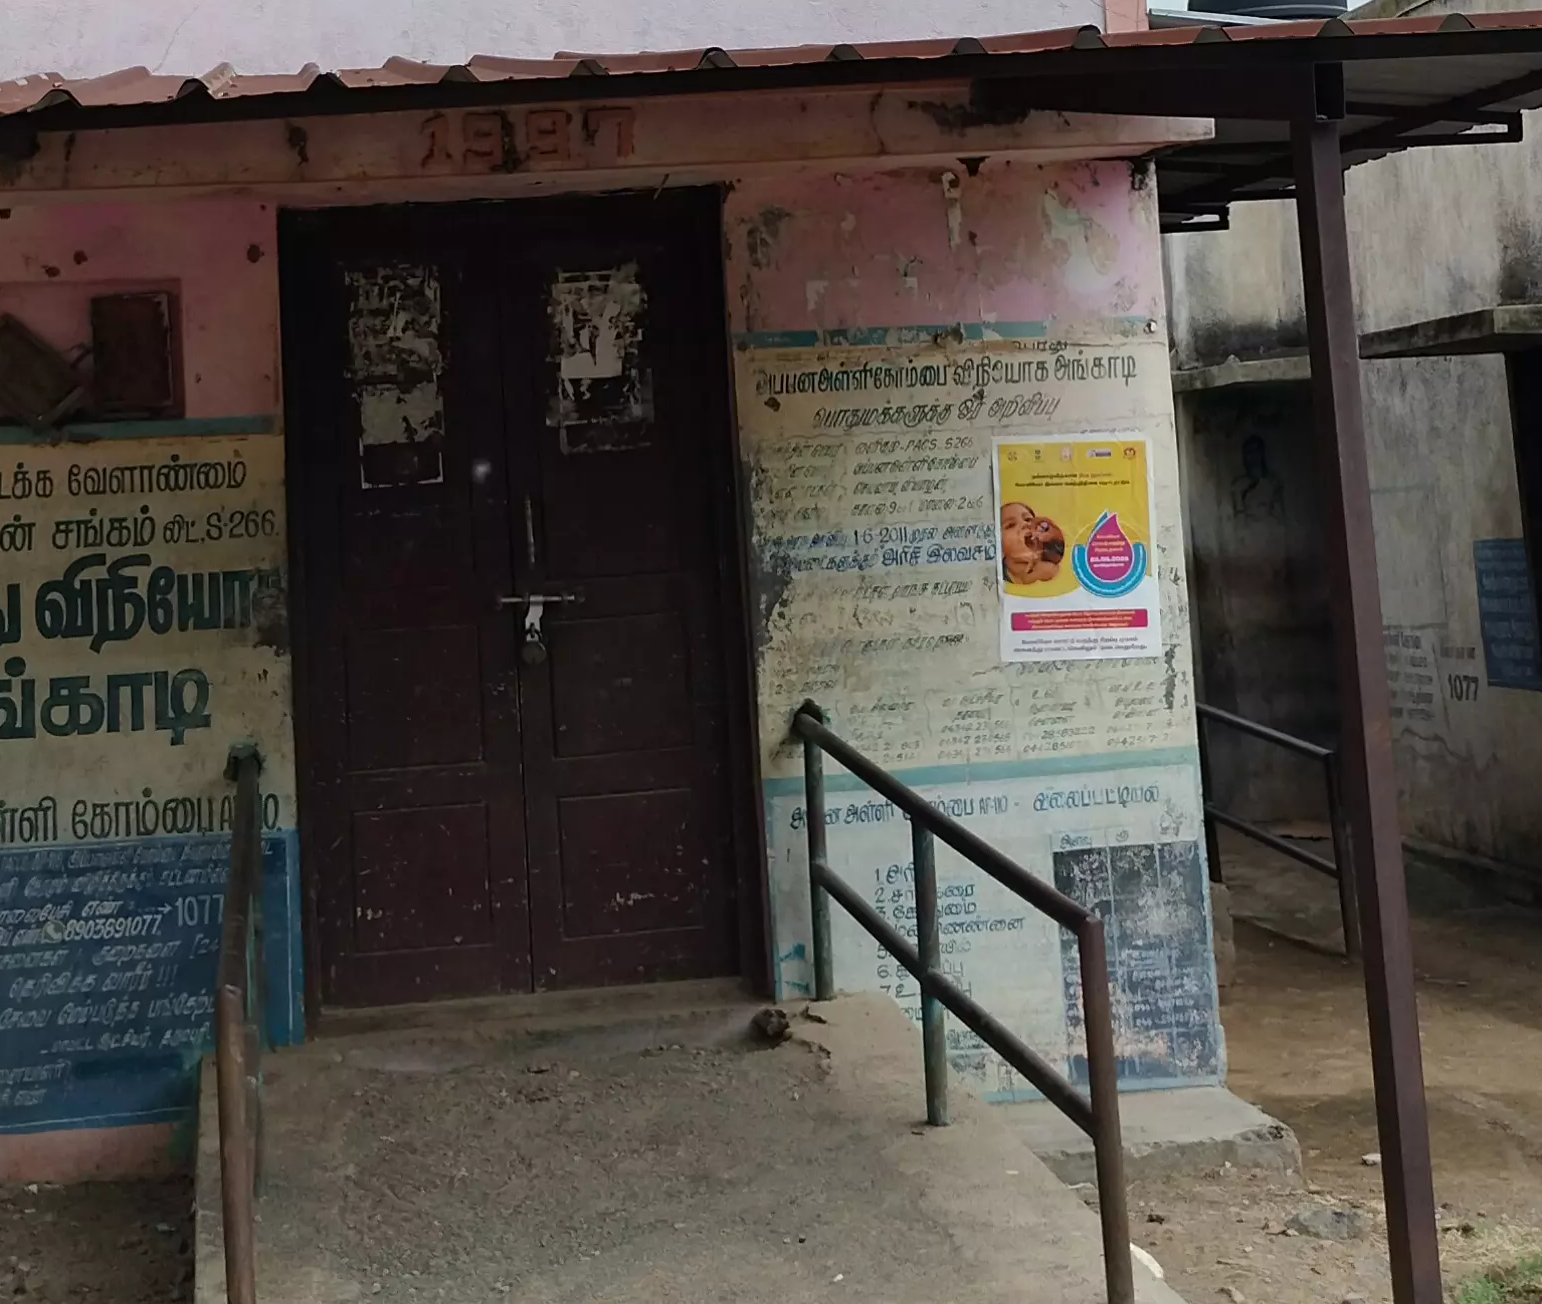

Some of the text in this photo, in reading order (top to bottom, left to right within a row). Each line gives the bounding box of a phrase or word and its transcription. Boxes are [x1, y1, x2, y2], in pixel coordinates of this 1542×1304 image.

[1054, 348, 1138, 386] அங்காடி
[52, 504, 157, 551] சங்கம்
[70, 786, 215, 839] கோம்பை
